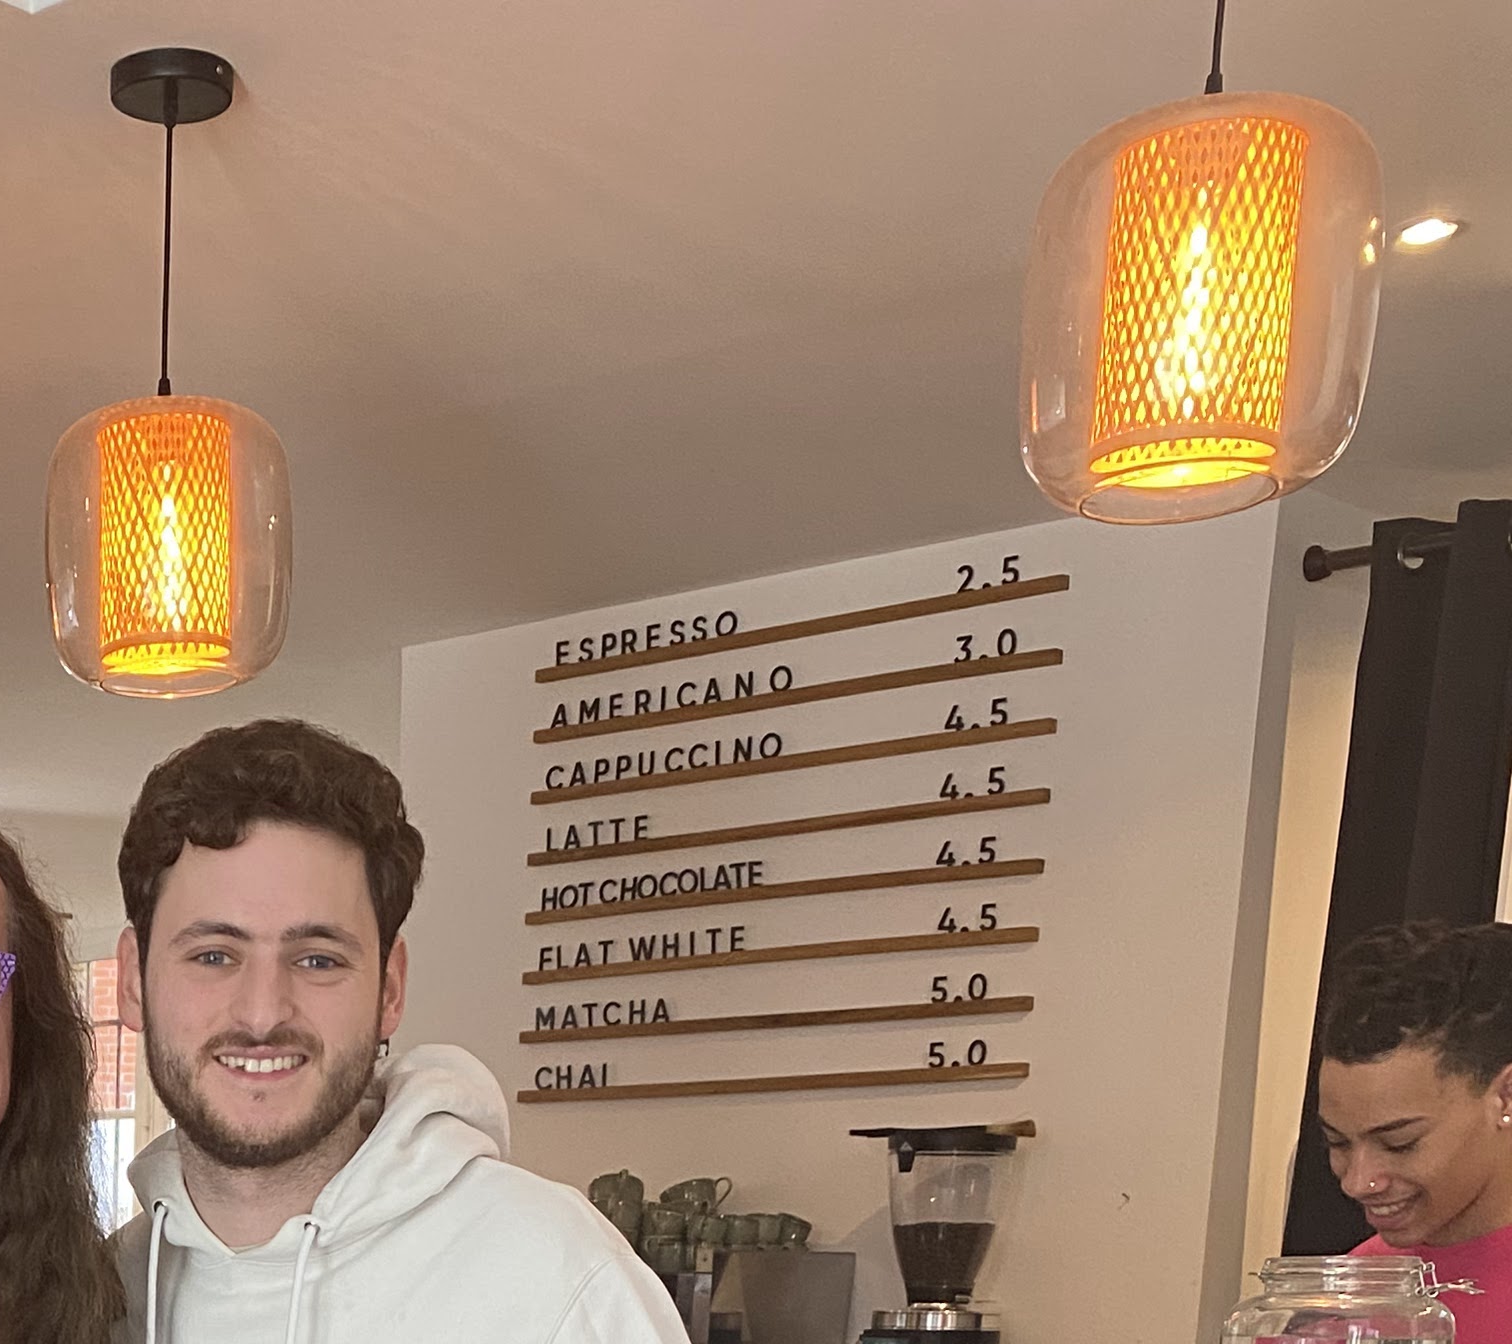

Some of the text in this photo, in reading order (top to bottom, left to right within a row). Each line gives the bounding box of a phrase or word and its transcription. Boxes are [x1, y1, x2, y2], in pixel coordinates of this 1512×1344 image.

[556, 555, 1019, 667] ESPRESSO 2.5
[550, 628, 1017, 730] AMERICANO 3.0
[545, 698, 1008, 791] CAPPUCCINO 4.5
[546, 767, 1005, 852] LATTE 4.5
[541, 837, 996, 913] HOT CHOCOLATE 4.5
[538, 904, 997, 971] FLAT WHITE 4.5
[536, 974, 987, 1031] MATCHA 5.0
[535, 1040, 987, 1091] CHAI 5.0
